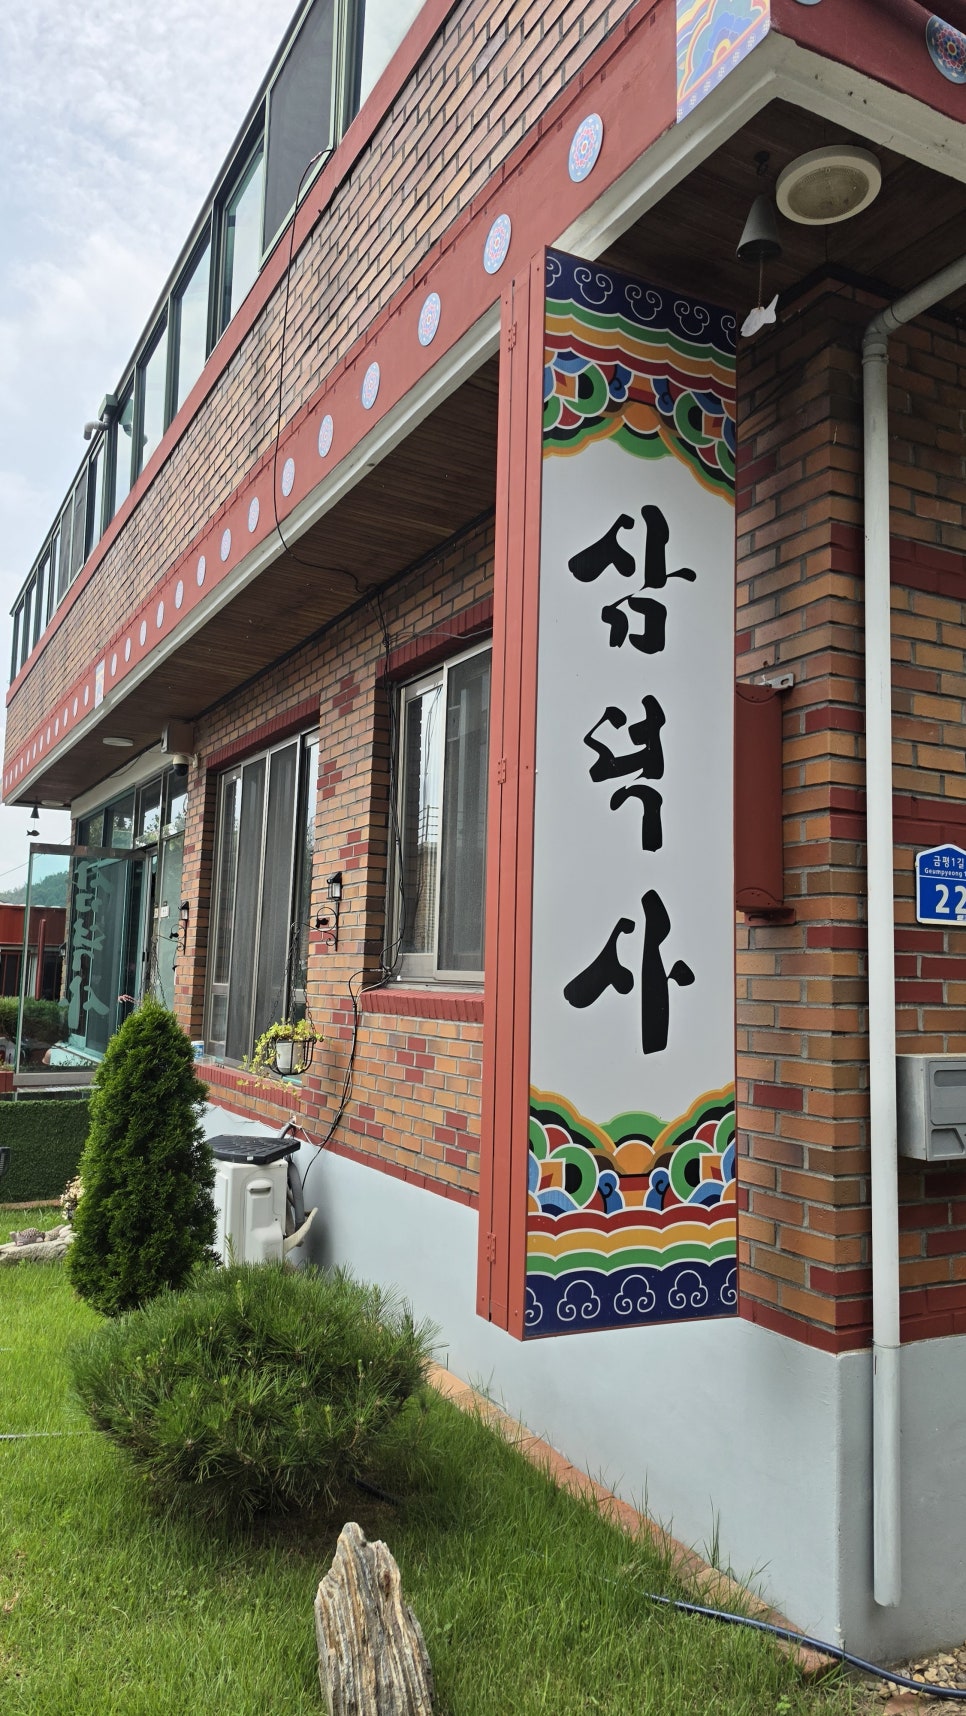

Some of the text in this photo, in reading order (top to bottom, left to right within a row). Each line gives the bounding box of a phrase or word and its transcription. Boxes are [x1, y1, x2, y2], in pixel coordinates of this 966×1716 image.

[564, 504, 697, 1055] 삼덕사
[924, 867, 963, 878] Geumpyeong
[933, 855, 965, 870] 금평1길
[935, 883, 966, 915] 22
